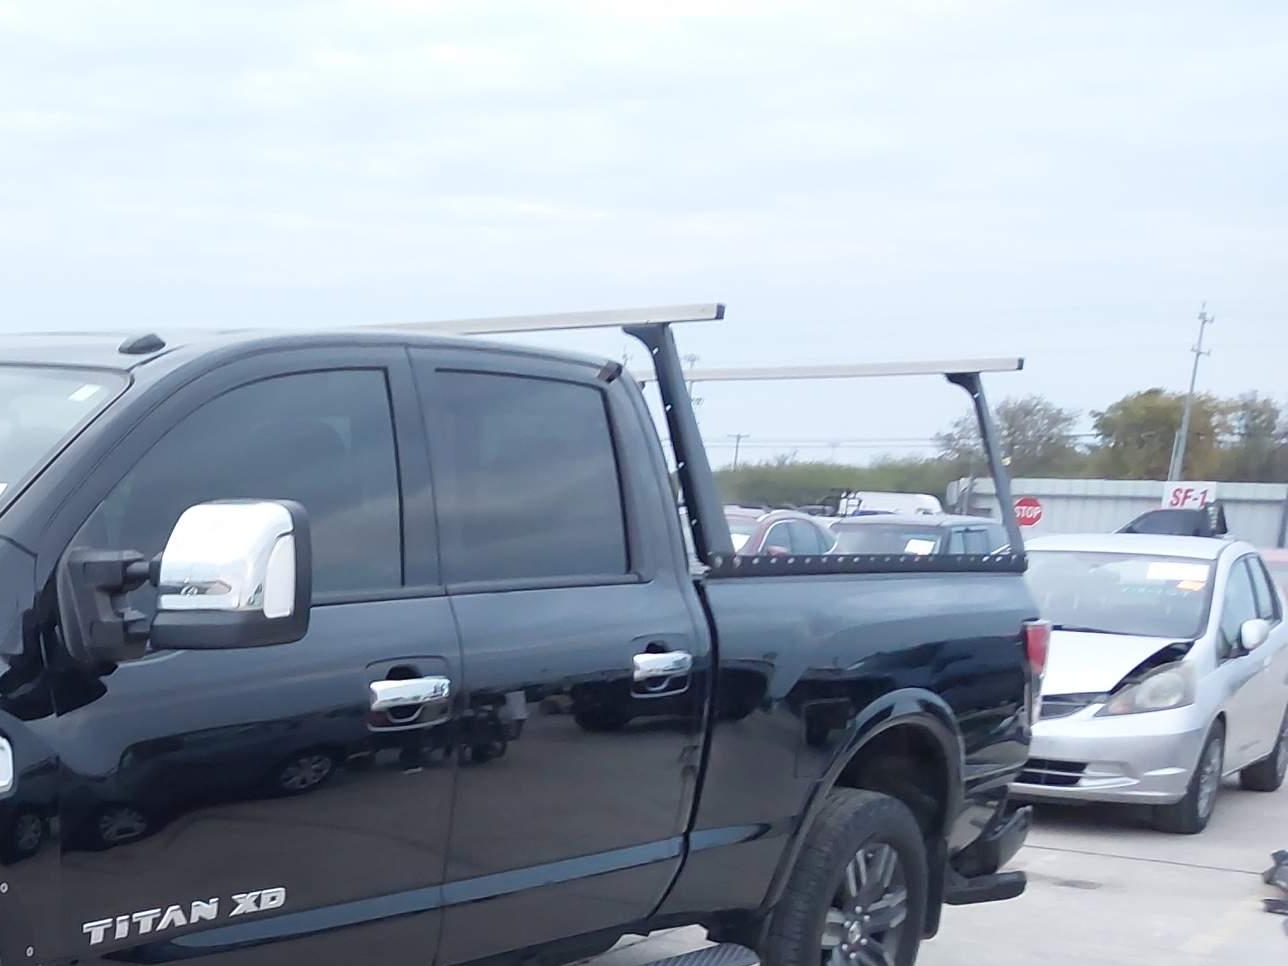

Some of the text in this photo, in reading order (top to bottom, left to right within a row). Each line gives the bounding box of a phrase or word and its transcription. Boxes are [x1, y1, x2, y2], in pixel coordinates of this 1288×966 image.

[1169, 487, 1209, 508] SF-1
[1015, 505, 1042, 519] STOP
[82, 886, 287, 946] TITAN XD
